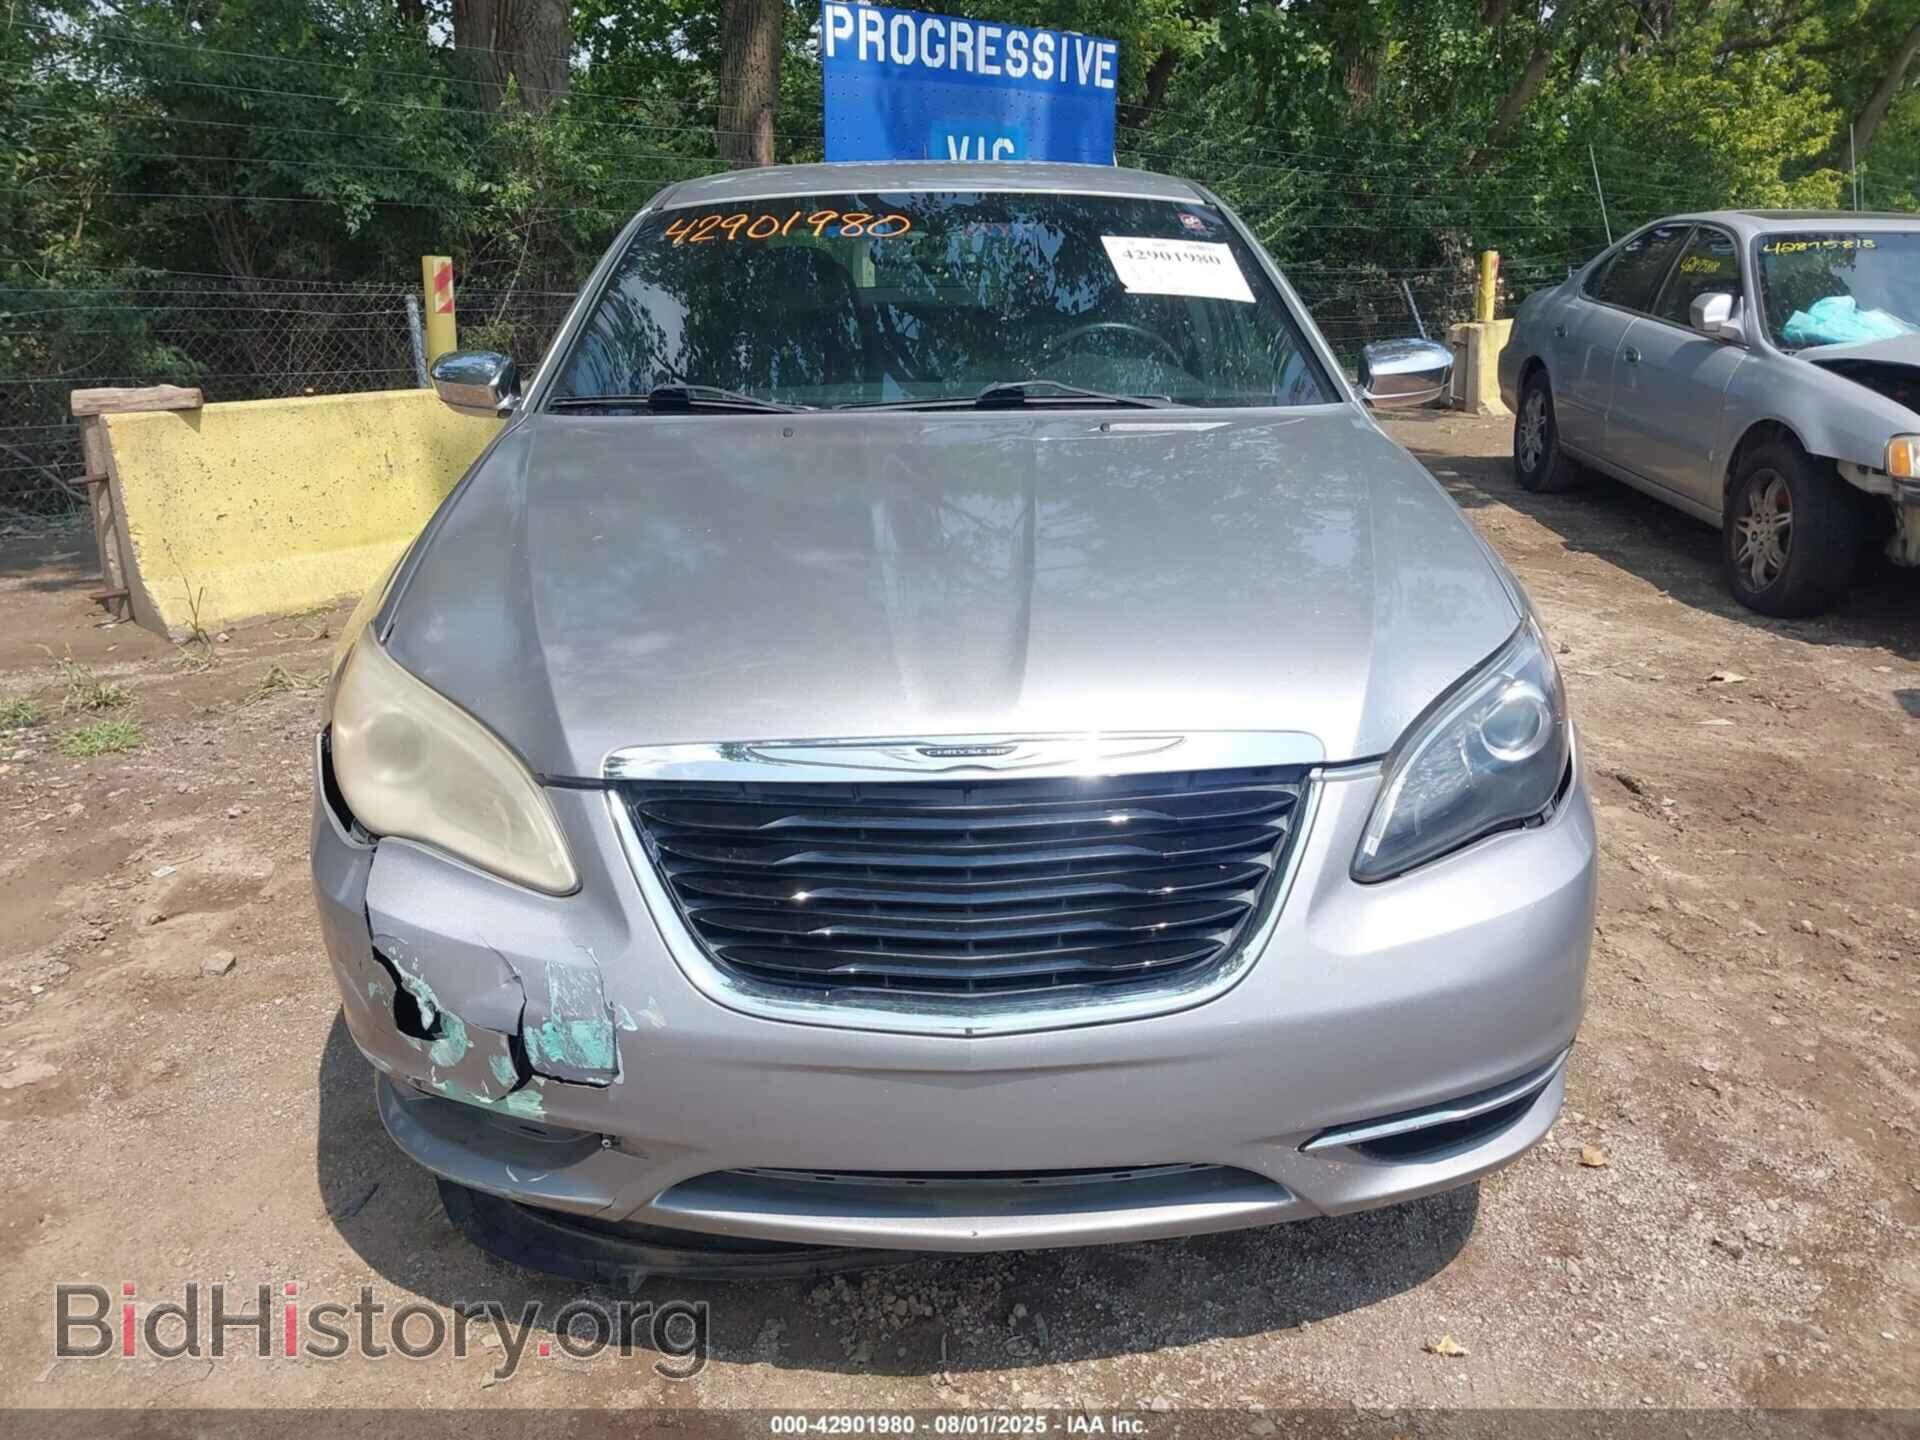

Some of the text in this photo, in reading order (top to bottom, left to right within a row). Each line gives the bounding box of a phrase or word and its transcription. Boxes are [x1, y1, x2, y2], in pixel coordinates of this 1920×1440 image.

[825, 4, 1117, 89] PROGRESSIVE
[664, 210, 912, 247] 42901980
[1122, 248, 1222, 265] 42901980
